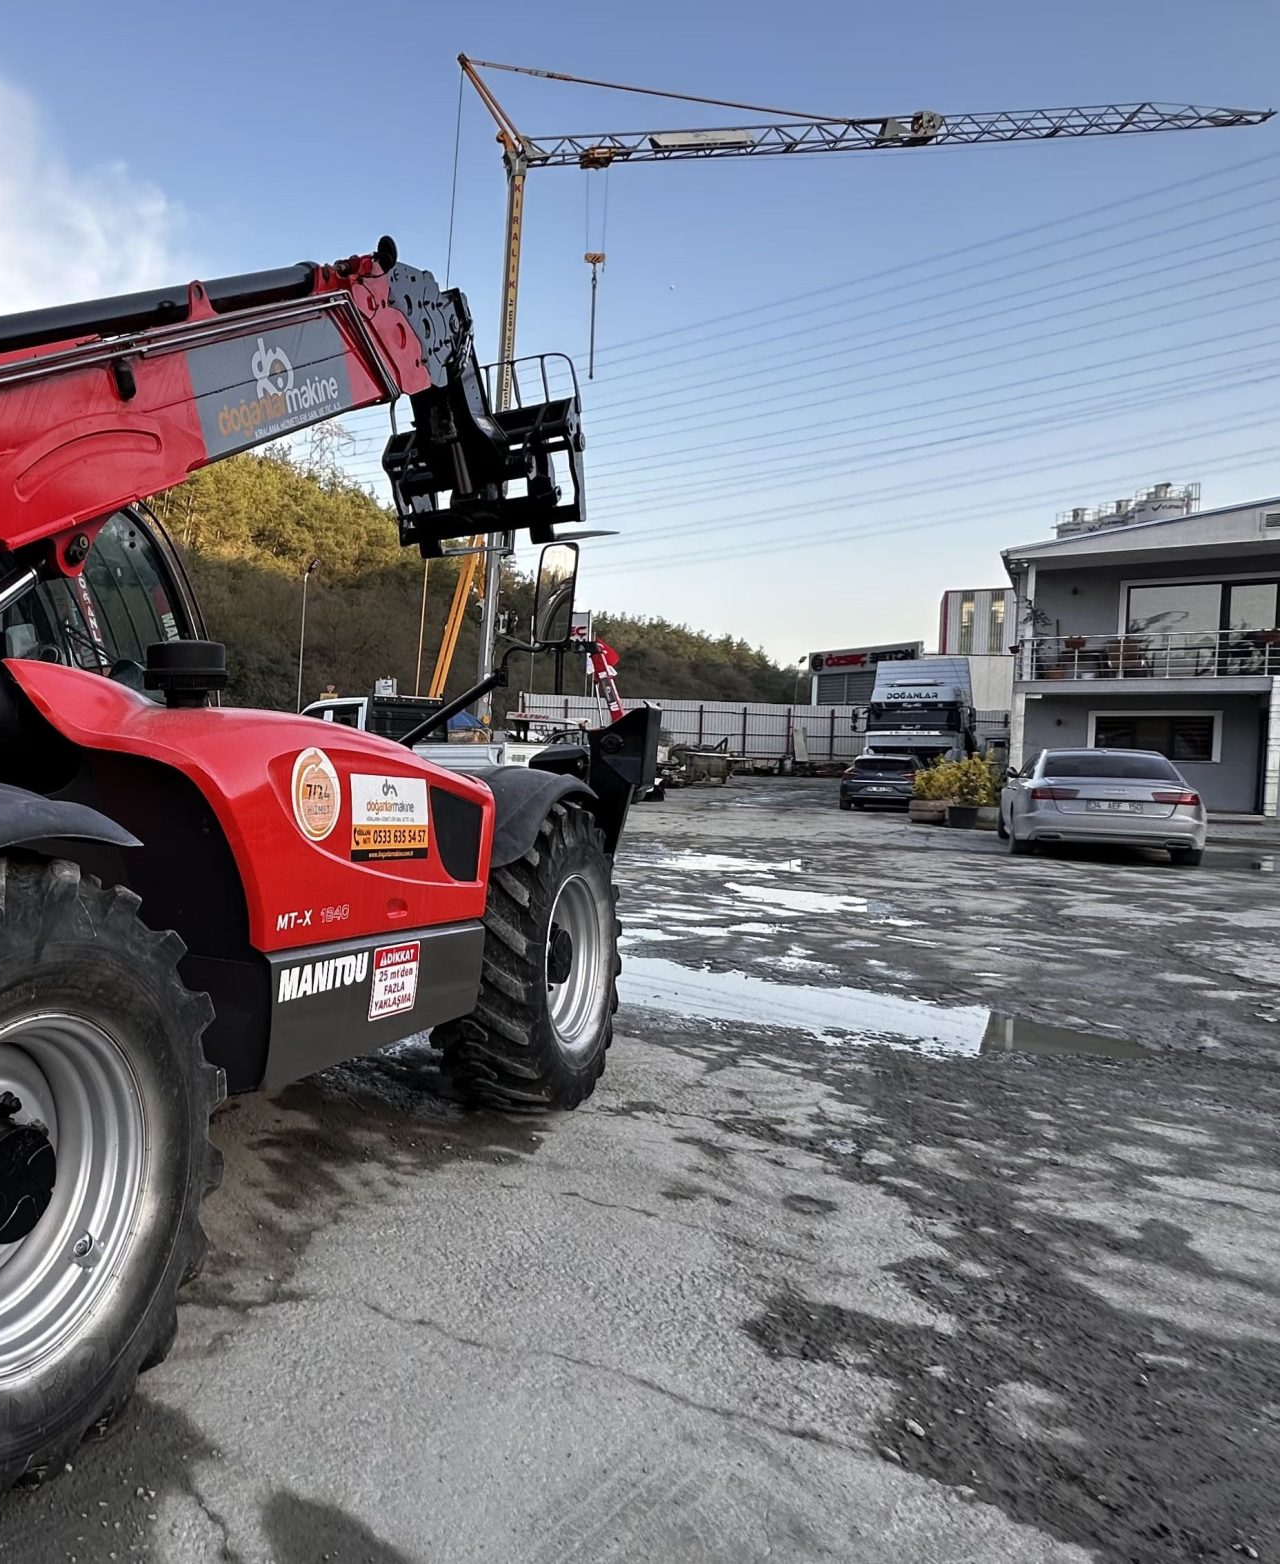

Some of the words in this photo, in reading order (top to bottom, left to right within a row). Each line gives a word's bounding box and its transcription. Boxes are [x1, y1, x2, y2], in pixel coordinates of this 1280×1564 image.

[373, 829, 392, 844] 0533
[393, 829, 406, 844] 635
[408, 829, 417, 843] 54
[417, 829, 426, 843] 57
[276, 908, 314, 931] MT-X
[320, 904, 350, 924] 1840
[387, 947, 415, 964] DİKKAT
[278, 951, 369, 1003] MANITOU
[378, 970, 389, 983] 25
[383, 981, 405, 996] FAZLA
[374, 995, 412, 1011] YAKLAŞMA
